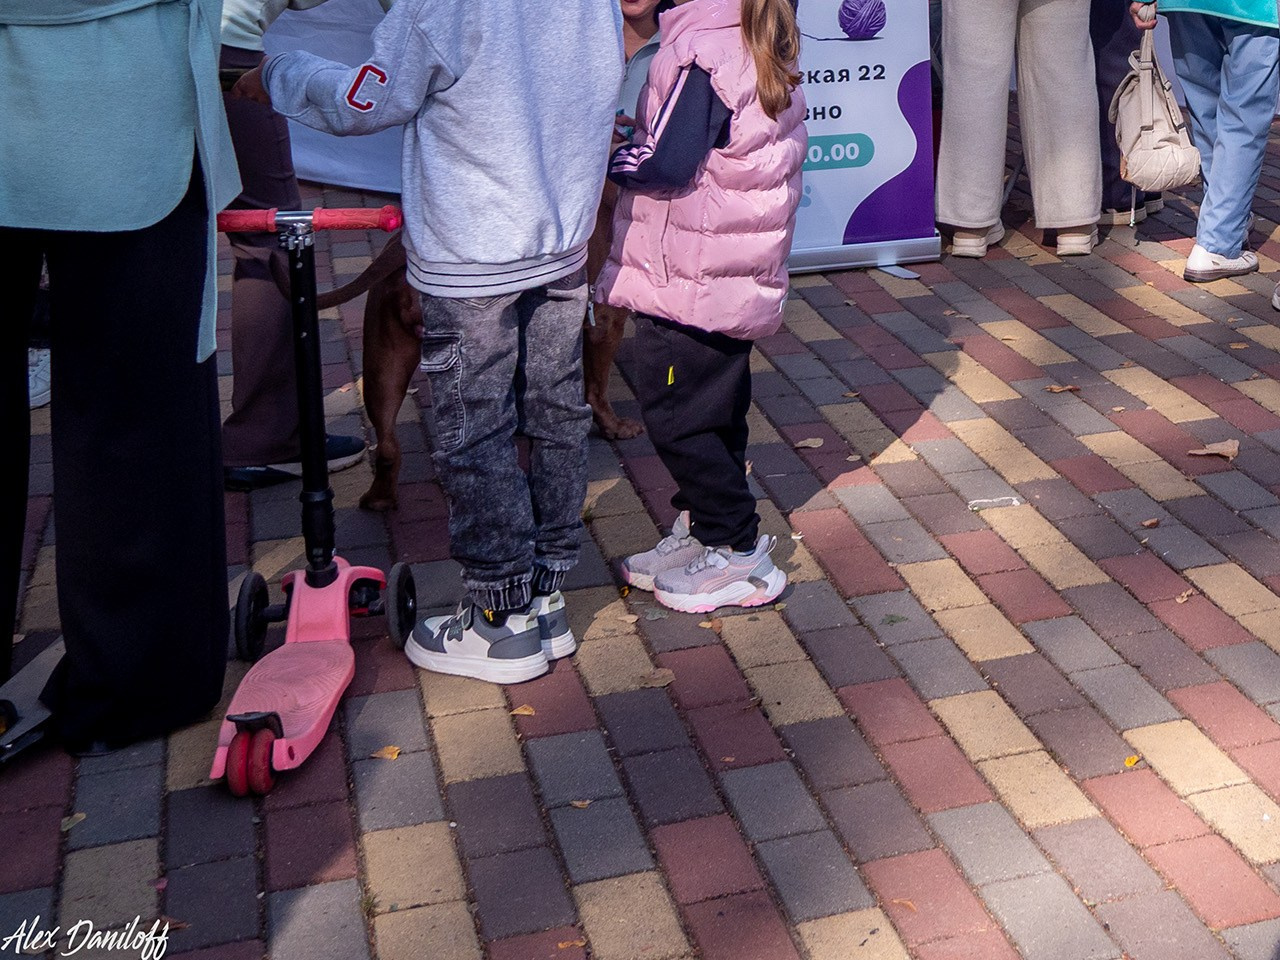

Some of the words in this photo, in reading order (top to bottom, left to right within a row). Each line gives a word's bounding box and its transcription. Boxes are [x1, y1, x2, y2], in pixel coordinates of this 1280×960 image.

[857, 64, 887, 81] 22
[345, 64, 388, 113] C
[804, 142, 860, 164] 0.00
